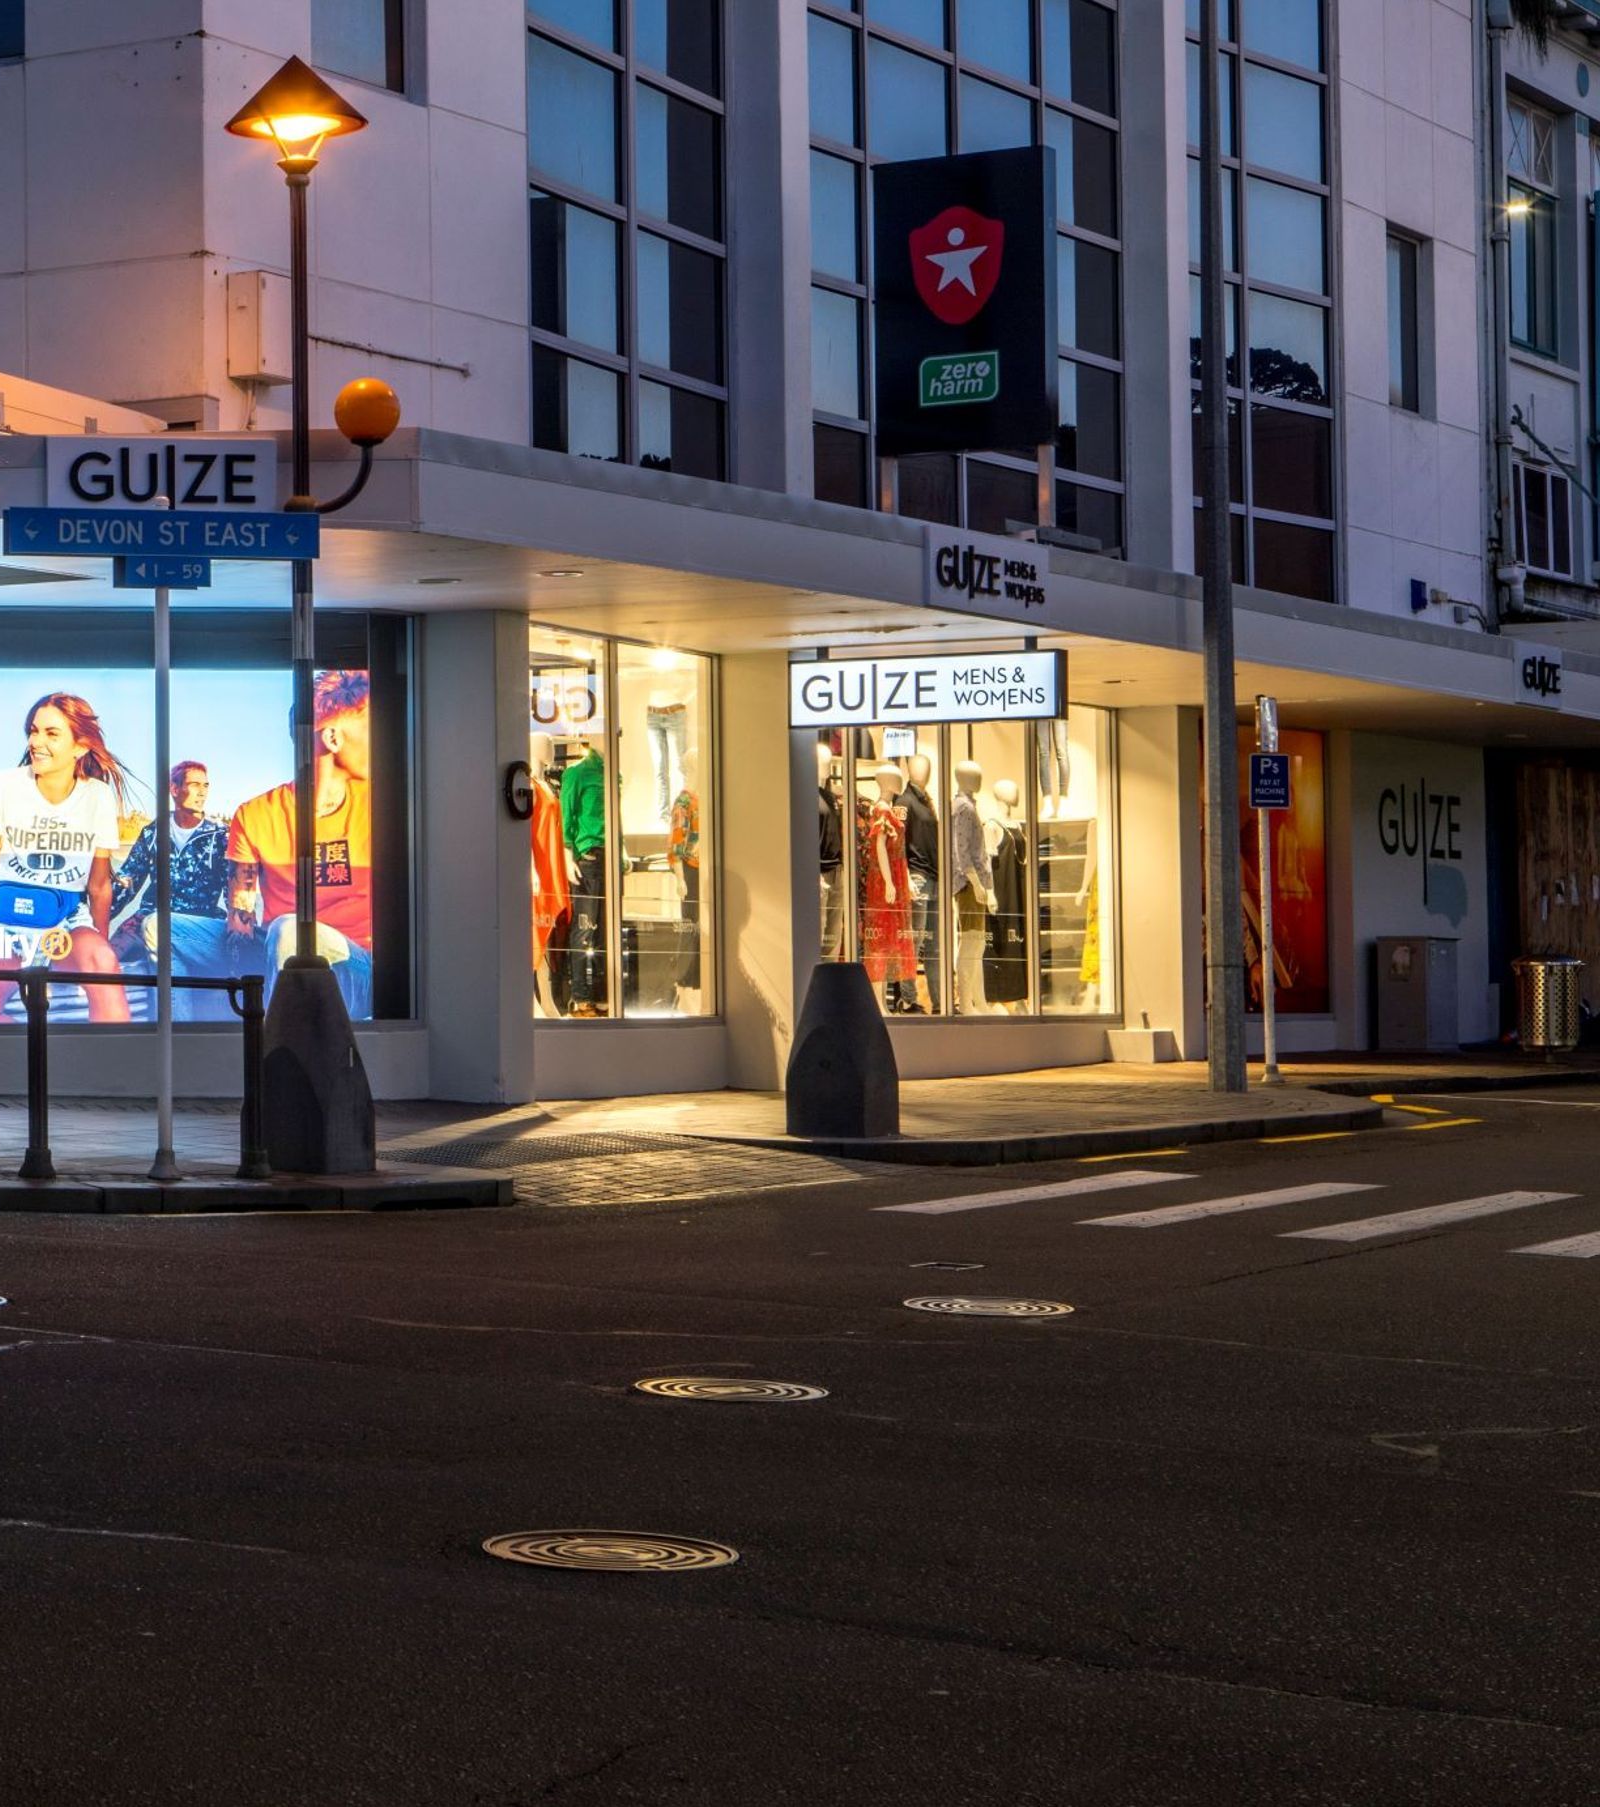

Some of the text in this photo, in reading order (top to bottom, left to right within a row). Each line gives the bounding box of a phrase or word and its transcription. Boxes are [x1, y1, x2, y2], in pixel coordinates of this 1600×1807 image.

[929, 378, 984, 397] harm
[68, 445, 257, 511] GUIZE
[58, 518, 271, 548] DEVON ST EAST
[182, 564, 203, 579] 59
[936, 545, 1001, 600] GUIZE
[1004, 558, 1029, 580] MENS
[1004, 581, 1046, 609] WOMENS
[953, 666, 1025, 686] MENS &
[1522, 655, 1562, 697] GUIZE
[801, 663, 938, 720] GUIZE
[953, 687, 1046, 712] WOMENS
[505, 760, 534, 820] G
[1255, 787, 1286, 796] MACHINE
[1377, 778, 1462, 907] GUIZE
[40, 855, 55, 869] 10
